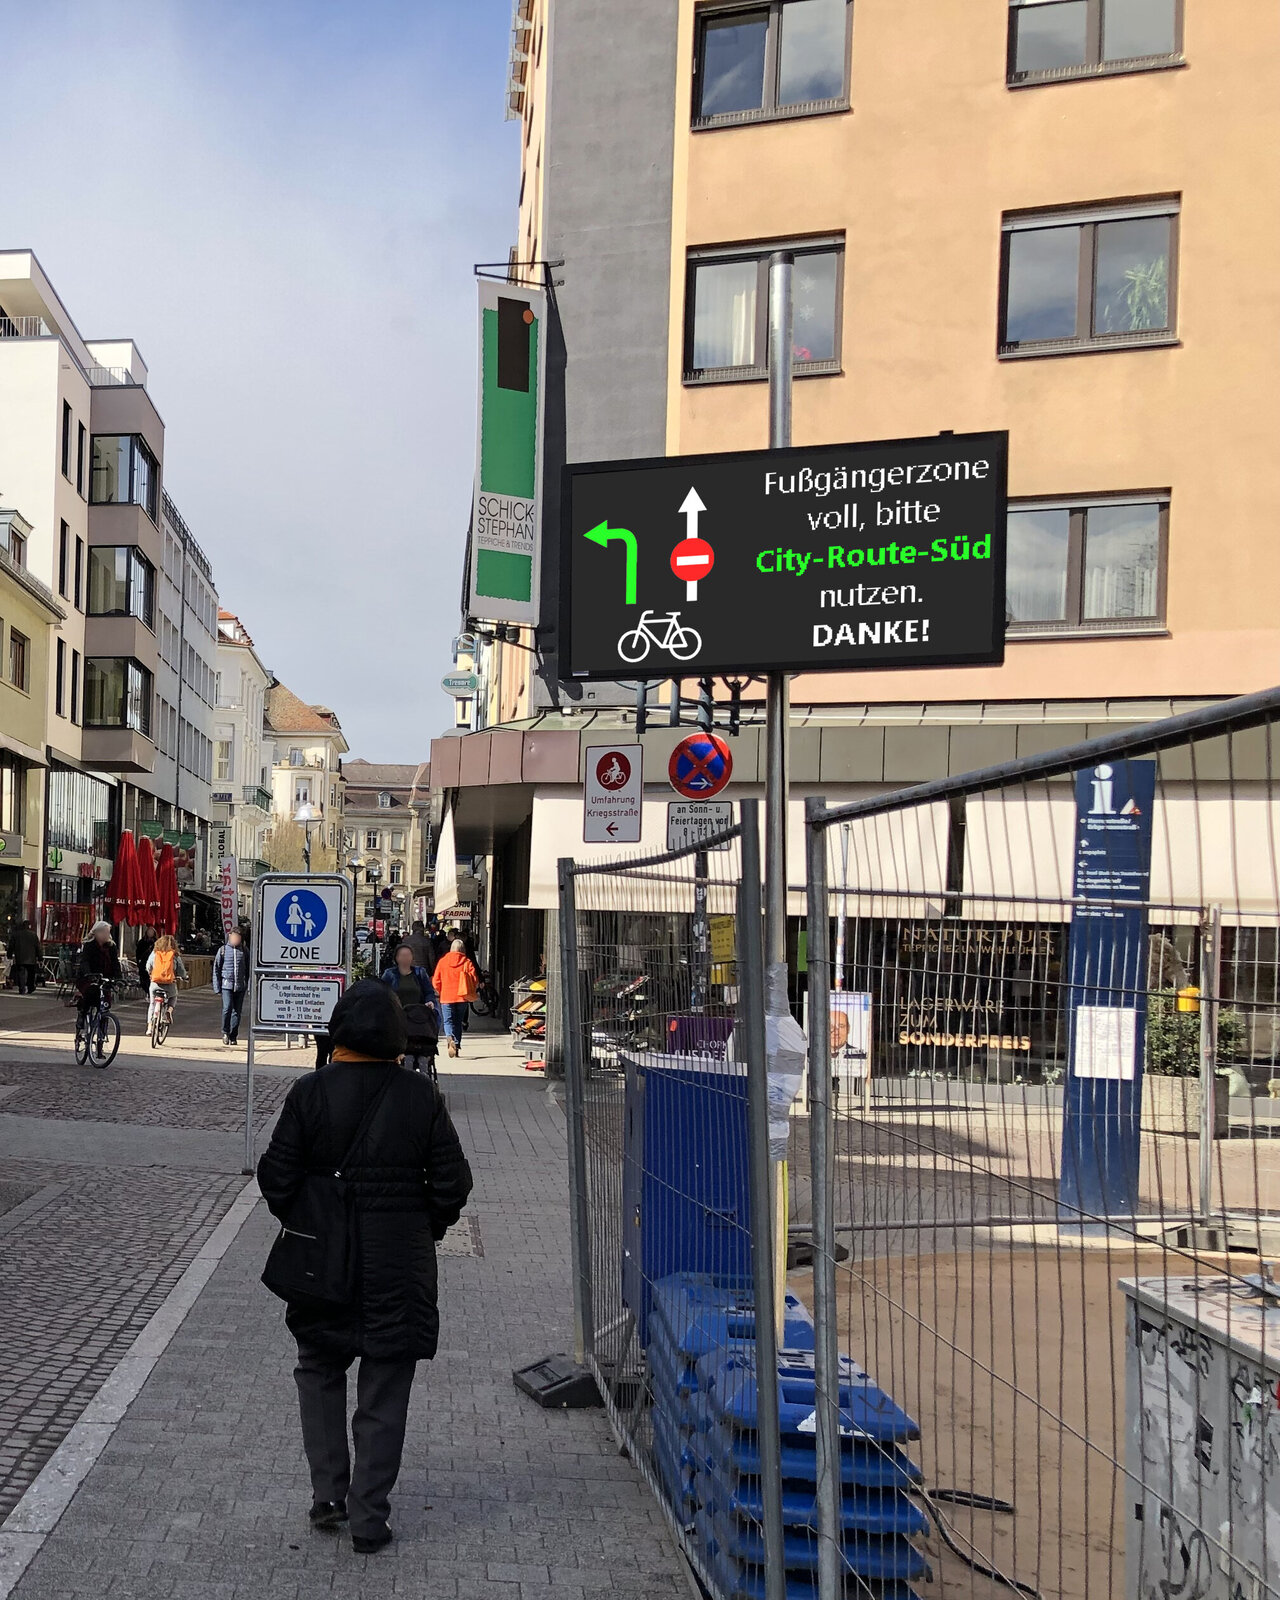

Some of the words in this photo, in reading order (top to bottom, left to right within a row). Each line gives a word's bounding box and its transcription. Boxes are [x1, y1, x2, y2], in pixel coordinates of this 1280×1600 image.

[764, 459, 990, 497] Fußgängerzone
[478, 496, 535, 523] SCHICK-
[806, 503, 866, 532] voll,
[876, 500, 941, 526] bitte
[477, 517, 534, 541] STEPHAN
[477, 536, 505, 548] TEPPICHE
[511, 541, 534, 552] TRENDS
[756, 533, 991, 577] City-Route-Süd
[820, 583, 924, 609] nutzen.
[812, 619, 930, 648] DANKE!
[591, 795, 635, 805] Umfahrung
[586, 808, 639, 819] Kriegsstraße
[670, 816, 713, 827] Feiertagen
[903, 928, 992, 943] NATUR
[1001, 929, 1055, 944] PUR
[280, 946, 320, 960] ZONE
[900, 996, 1004, 1014] LAGERWARE
[899, 1014, 938, 1028] ZUM
[898, 1031, 1032, 1050] SONDERPREIS
